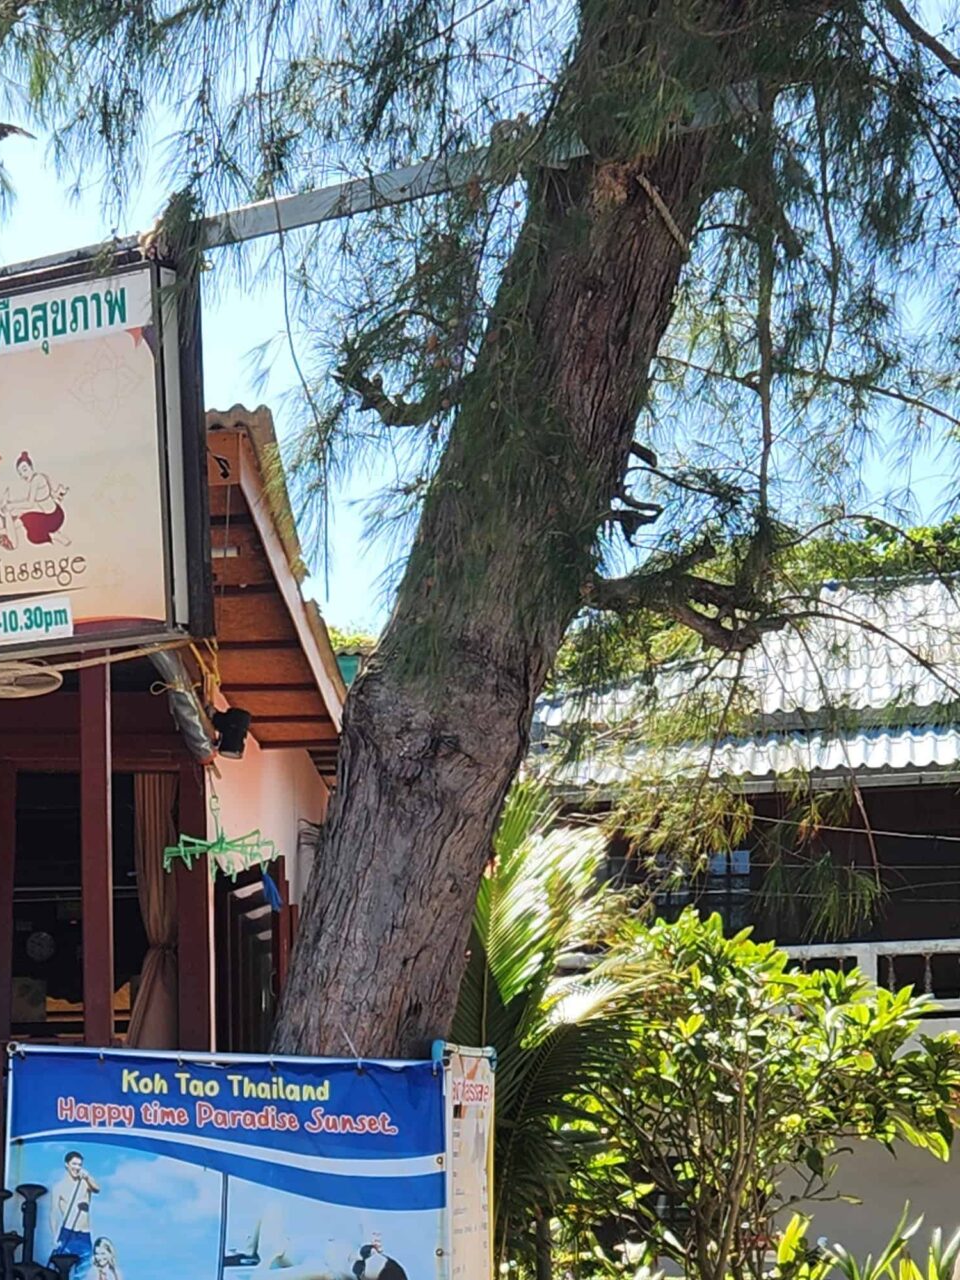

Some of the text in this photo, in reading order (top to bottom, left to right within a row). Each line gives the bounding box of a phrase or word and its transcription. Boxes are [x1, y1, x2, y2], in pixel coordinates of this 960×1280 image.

[121, 1069, 330, 1101] Koh Tao Thailand
[57, 1097, 399, 1135] Happy time Paradise Sunset.
